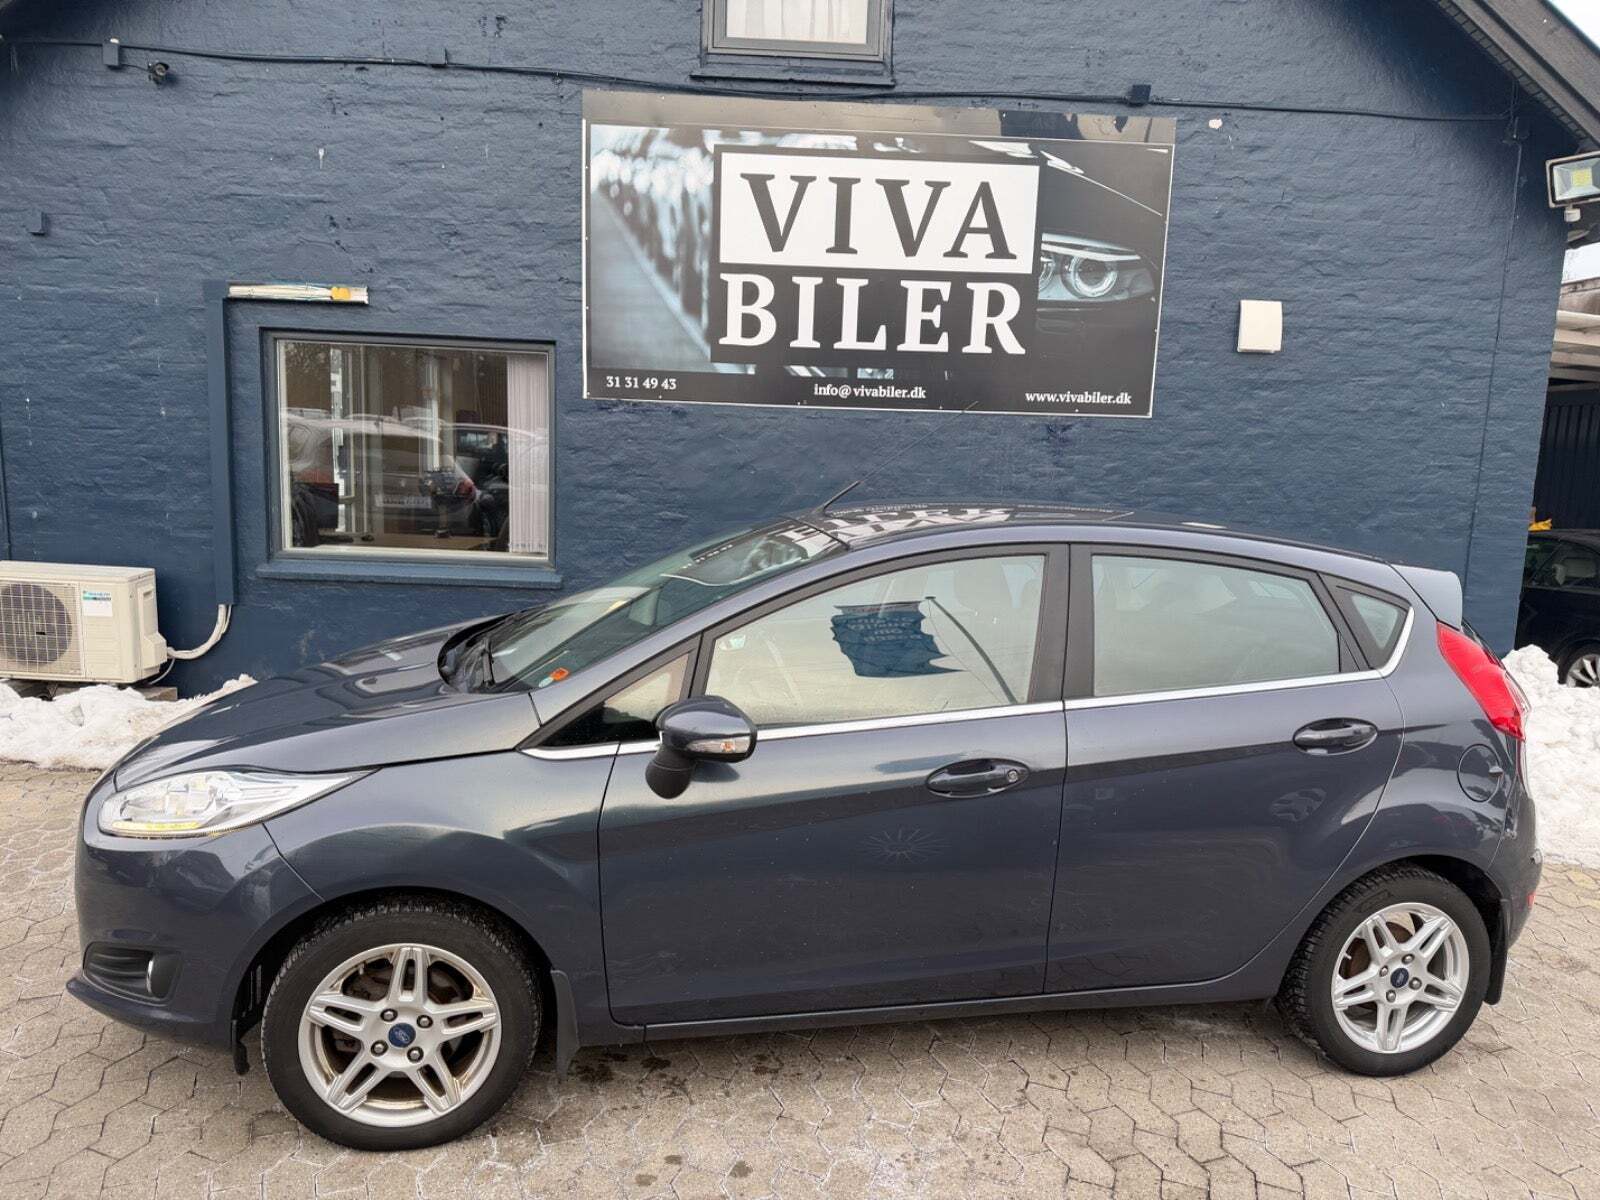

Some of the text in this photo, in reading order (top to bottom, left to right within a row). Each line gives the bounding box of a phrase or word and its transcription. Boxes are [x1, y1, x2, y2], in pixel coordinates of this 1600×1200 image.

[740, 173, 1017, 259] VIVA
[719, 273, 1026, 354] BILER
[606, 375, 677, 390] 31 31 49 43
[1025, 390, 1132, 405] www.vivabiler.dk
